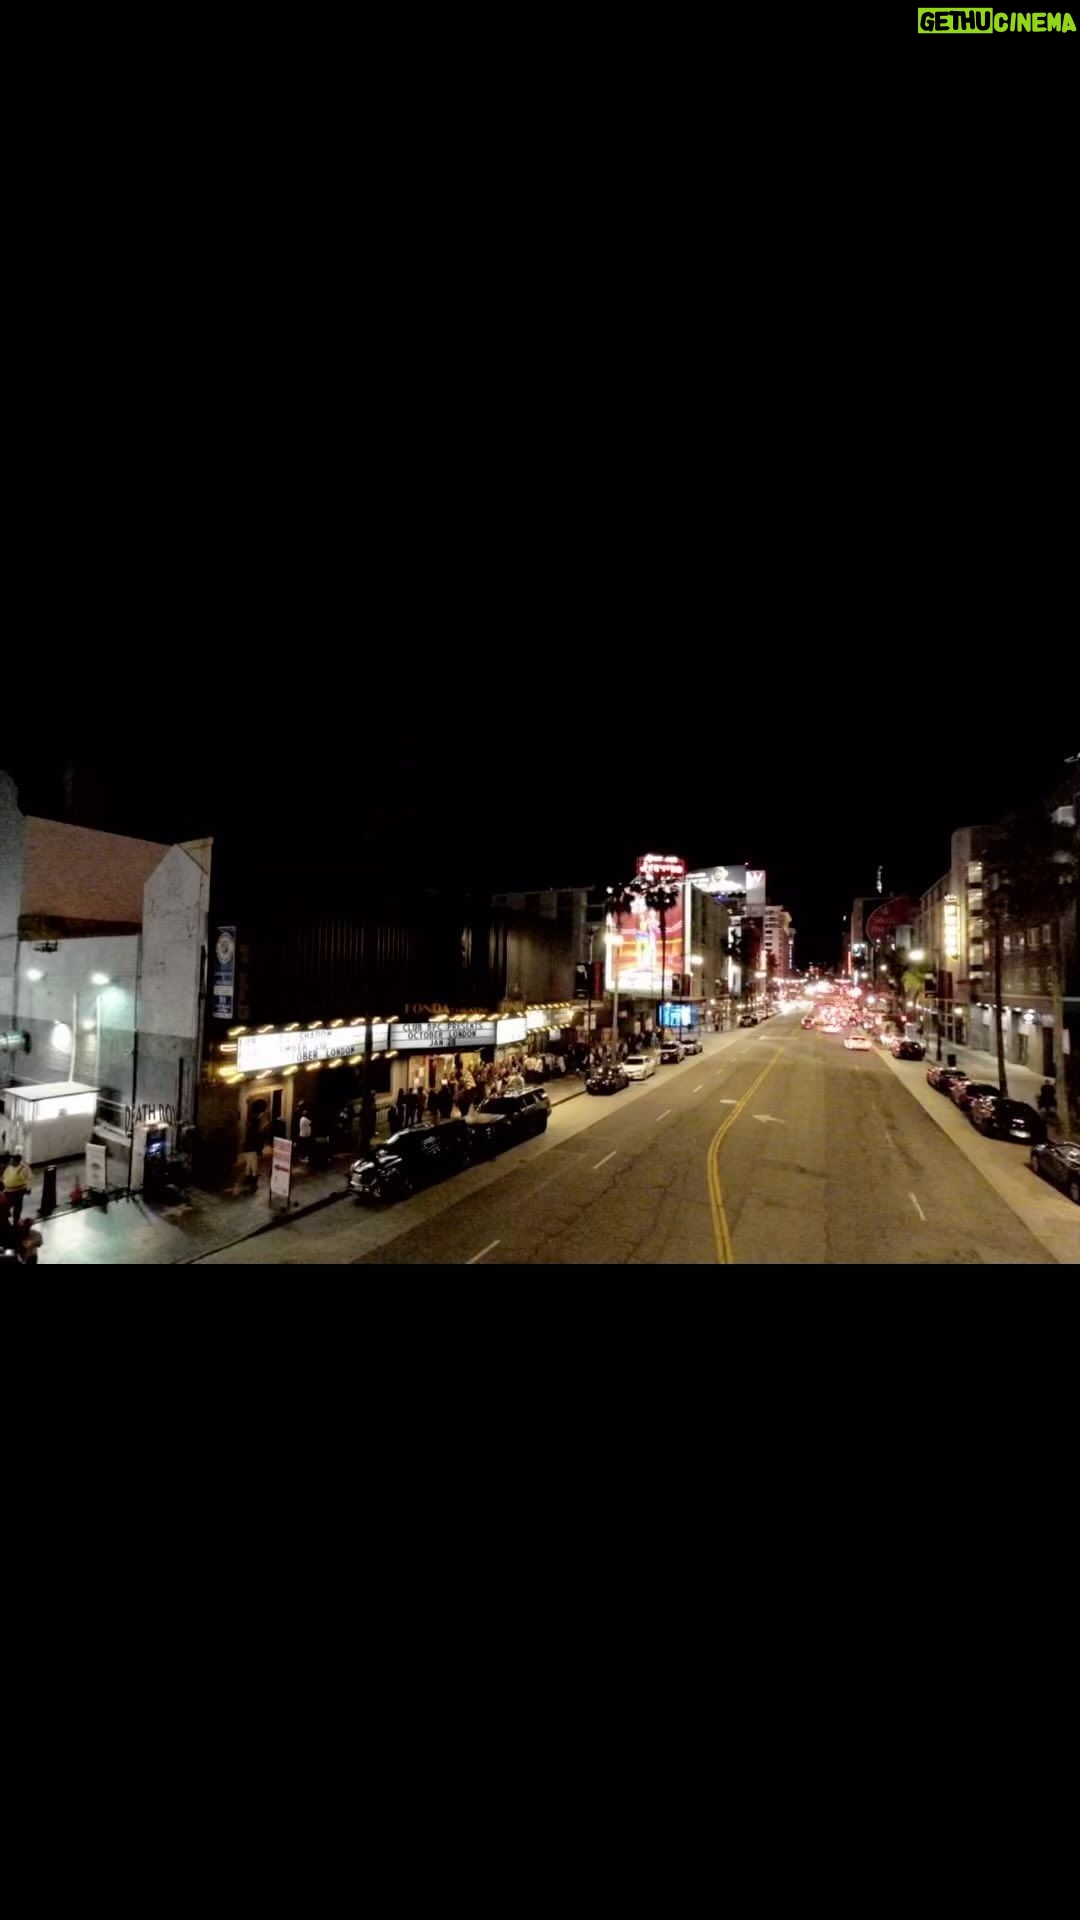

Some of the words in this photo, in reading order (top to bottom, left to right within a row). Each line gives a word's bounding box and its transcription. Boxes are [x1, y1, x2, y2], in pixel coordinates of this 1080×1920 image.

[403, 1002, 450, 1015] FONDA
[402, 1022, 423, 1032] CLUB
[447, 1022, 484, 1031] PRESENTS
[407, 1030, 443, 1040] OCTOBER
[448, 1030, 477, 1039] LONDON
[429, 1039, 444, 1047] JAN
[325, 1046, 356, 1059] LONDON
